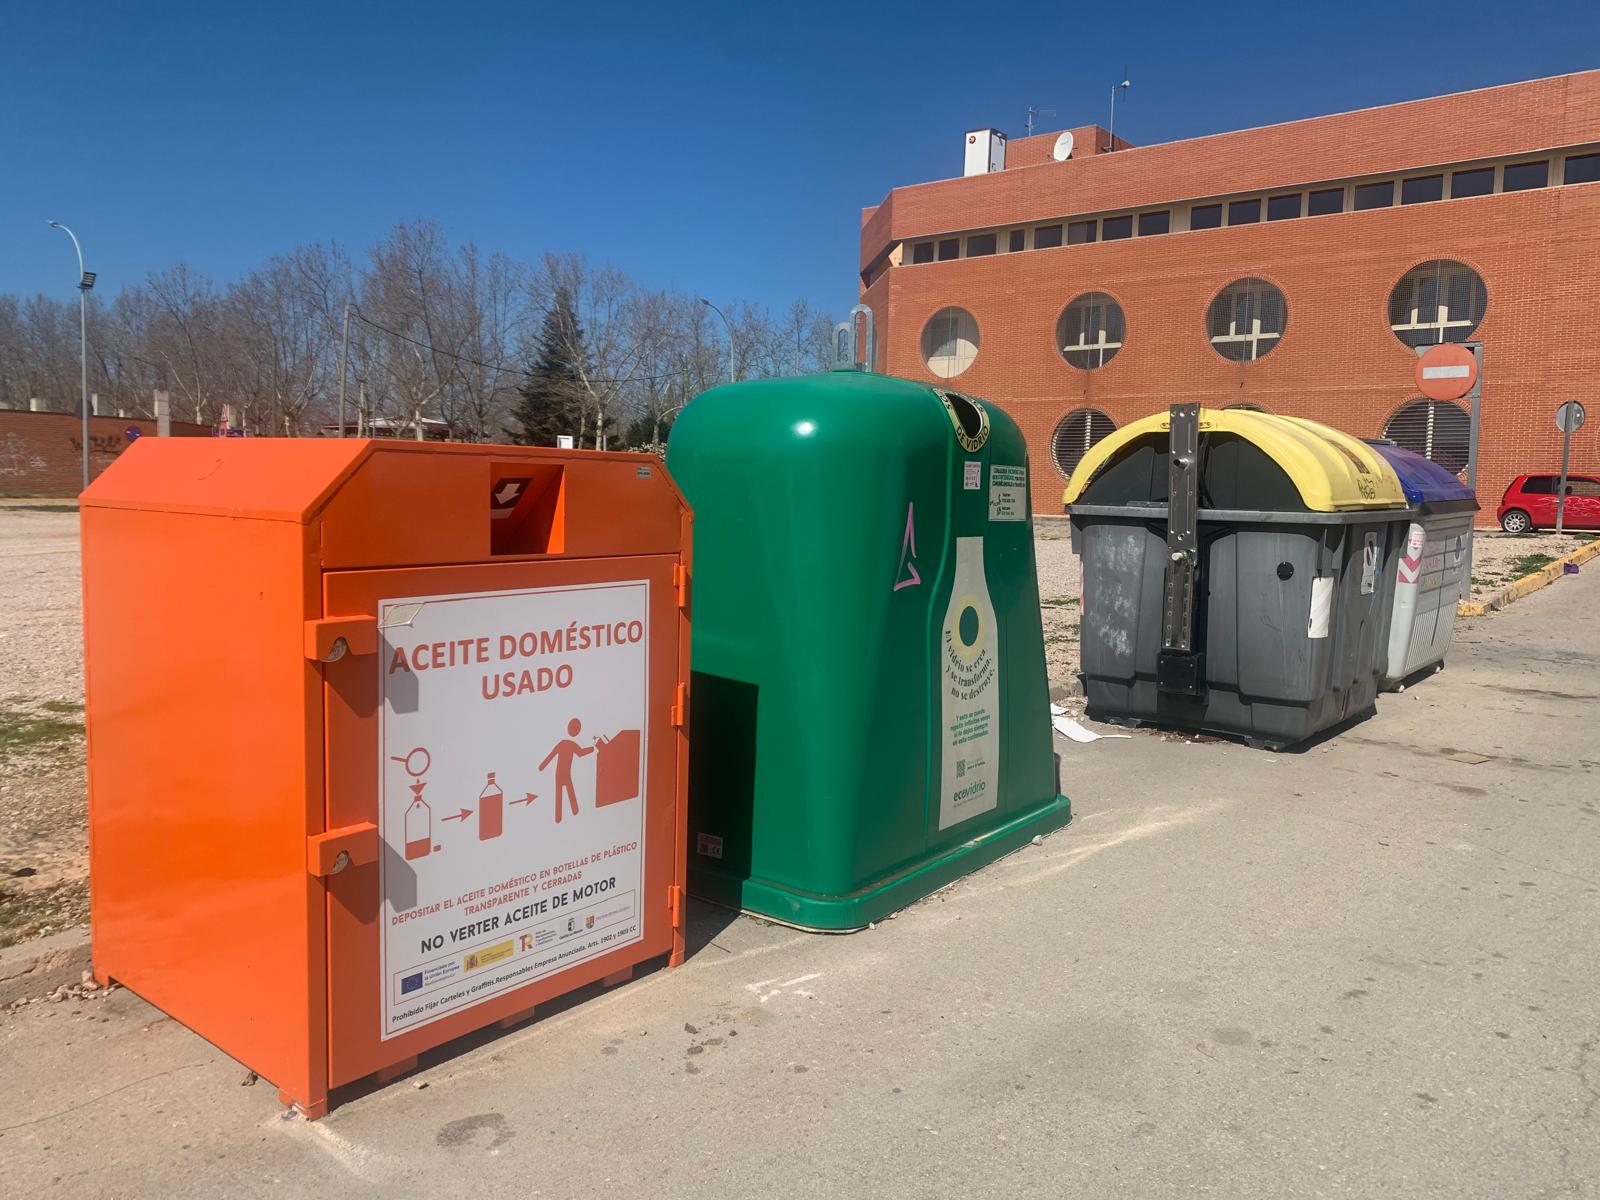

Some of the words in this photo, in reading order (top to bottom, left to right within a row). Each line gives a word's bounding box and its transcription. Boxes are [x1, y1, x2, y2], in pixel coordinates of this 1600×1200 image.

[957, 425, 965, 443] DE
[966, 425, 988, 451] VIDRIO
[389, 637, 490, 675] ACEITE
[499, 620, 643, 660] DOMÉSTICO
[948, 645, 964, 672] vidrio
[974, 649, 986, 669] crea
[481, 664, 573, 700] USADO
[953, 779, 986, 802] ecovidrio
[392, 903, 440, 926] DEPOSITAR
[443, 899, 453, 909] EL
[457, 889, 486, 906] ACEITE
[488, 873, 537, 894] DOMÉSTICO
[540, 868, 550, 879] EN
[553, 857, 588, 875] BOTELLAS
[591, 853, 601, 863] DE
[604, 841, 637, 859] PLÁSTICO
[464, 888, 530, 916] TRANSPARENTE
[532, 884, 538, 893] Y
[541, 871, 582, 890] CERRADAS
[421, 935, 444, 954] NO
[450, 916, 499, 943] VERTER
[504, 900, 548, 926] ACEITE
[552, 893, 568, 909] DE
[573, 877, 616, 902] MOTOR
[392, 1006, 424, 1023] Prohibido
[425, 1001, 439, 1012] Fijar
[440, 991, 465, 1005] Carteles
[534, 956, 557, 969] Empresa
